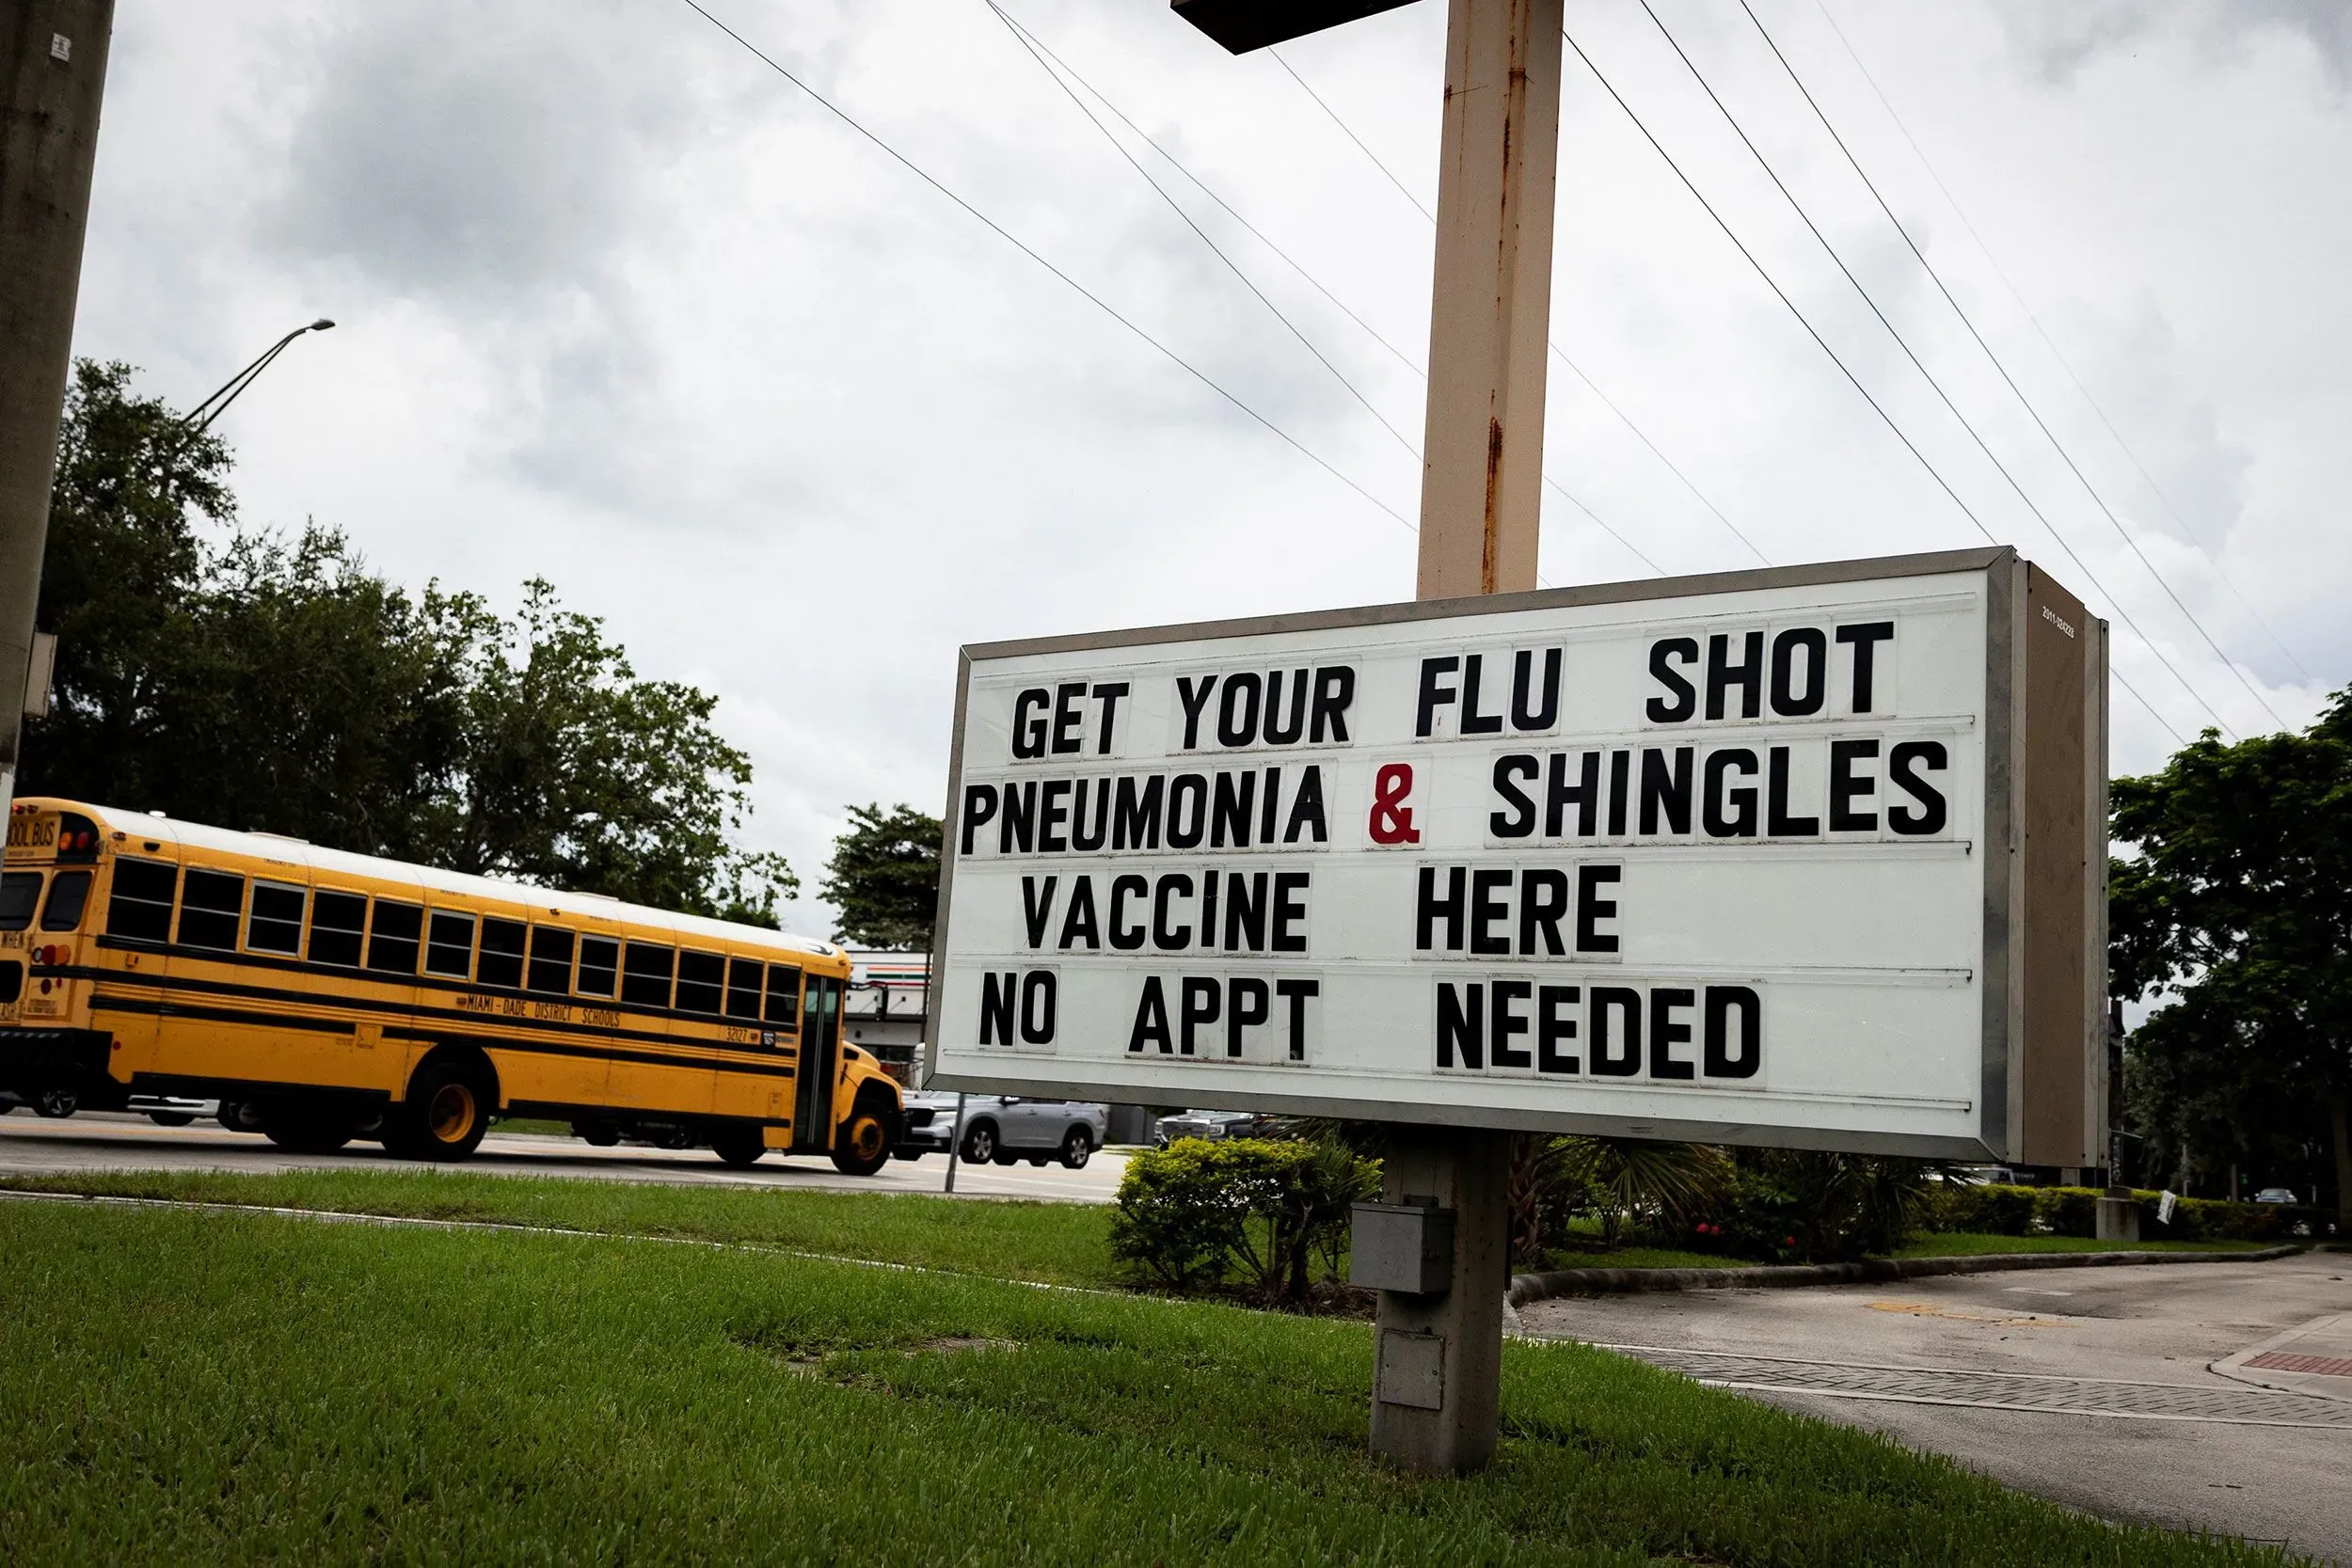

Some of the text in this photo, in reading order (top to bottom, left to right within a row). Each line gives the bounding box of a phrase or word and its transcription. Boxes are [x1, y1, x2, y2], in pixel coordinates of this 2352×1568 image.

[1012, 621, 1894, 760] GET YOUR FLU SHOT
[33, 820, 55, 846] BUS
[961, 739, 1947, 855] PNEUMONIA & SHINGLES
[1023, 864, 1620, 957] VACCINE HERE
[467, 993, 494, 1013] MIAMI
[503, 998, 527, 1017] DADE
[534, 1003, 572, 1022] DISTRICT
[581, 1008, 620, 1028] SCHOOLS
[978, 970, 1761, 1081] NO APPT NEEDED
